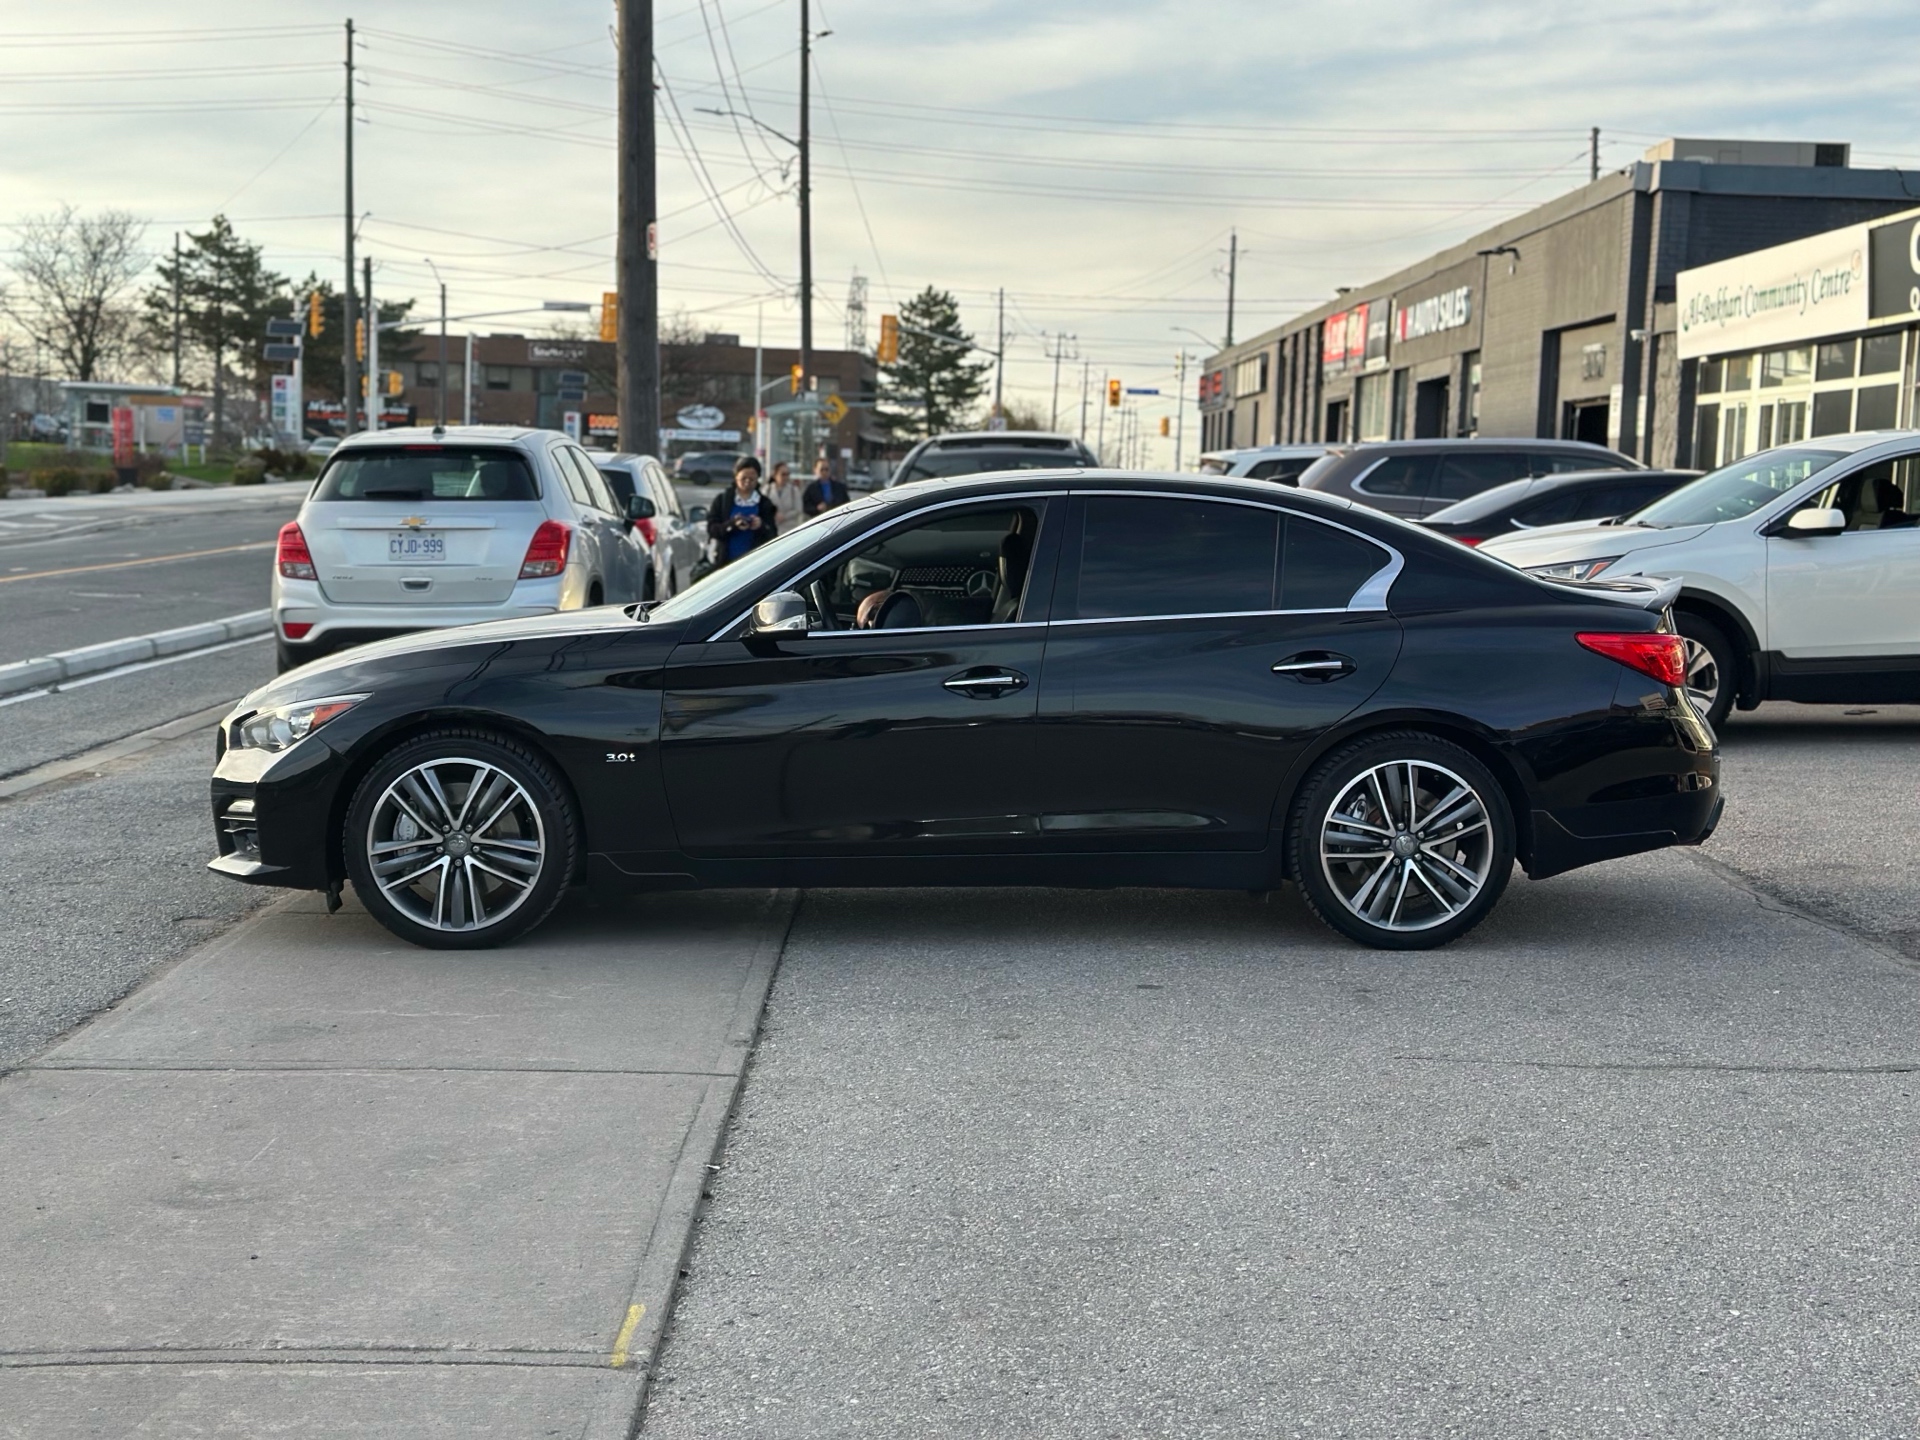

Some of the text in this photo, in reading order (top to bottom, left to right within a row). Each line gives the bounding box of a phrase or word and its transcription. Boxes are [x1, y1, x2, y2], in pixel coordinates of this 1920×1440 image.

[1438, 285, 1470, 332] SALES
[1682, 268, 1851, 332] Al-Bukhari Community Centre
[390, 539, 443, 554] CYJD 999
